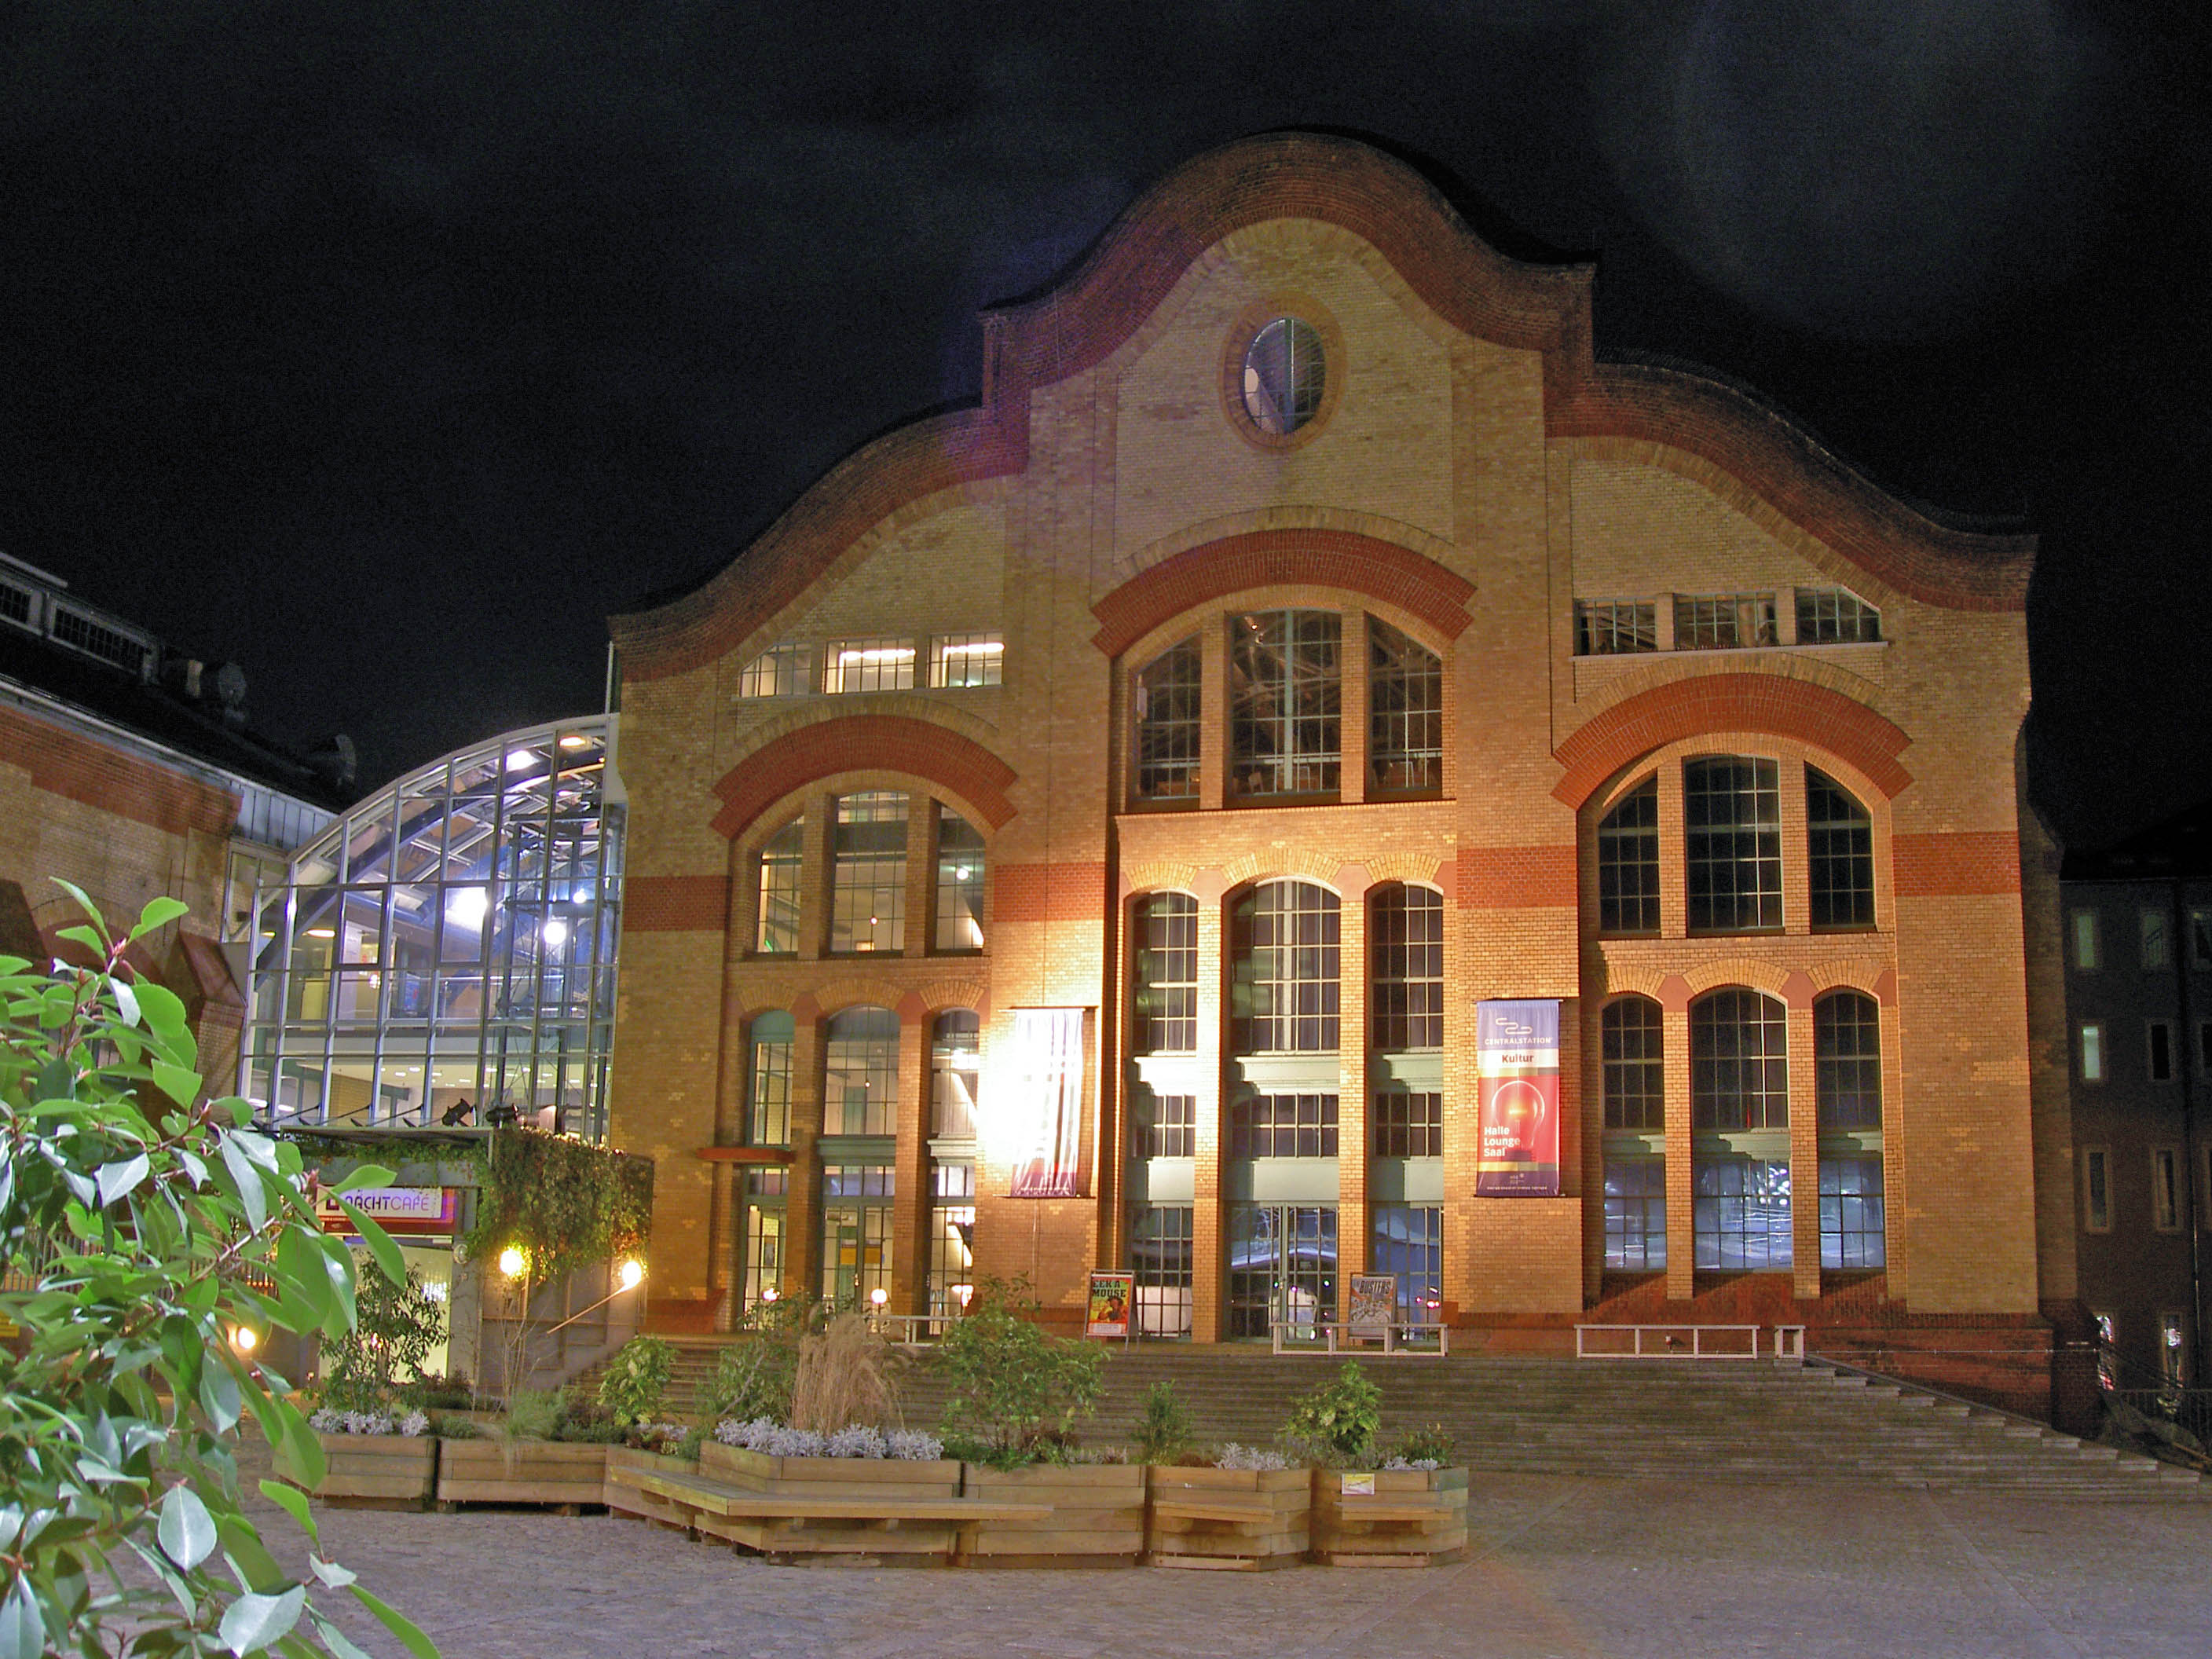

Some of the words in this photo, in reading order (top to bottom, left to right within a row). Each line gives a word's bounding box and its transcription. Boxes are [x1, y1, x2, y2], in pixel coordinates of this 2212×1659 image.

[1501, 1053, 1534, 1063] Kultur
[1484, 1126, 1510, 1136] Halle
[1484, 1137, 1521, 1148] Lounge
[1483, 1148, 1506, 1157] Saal
[1093, 1289, 1126, 1298] MOUSE
